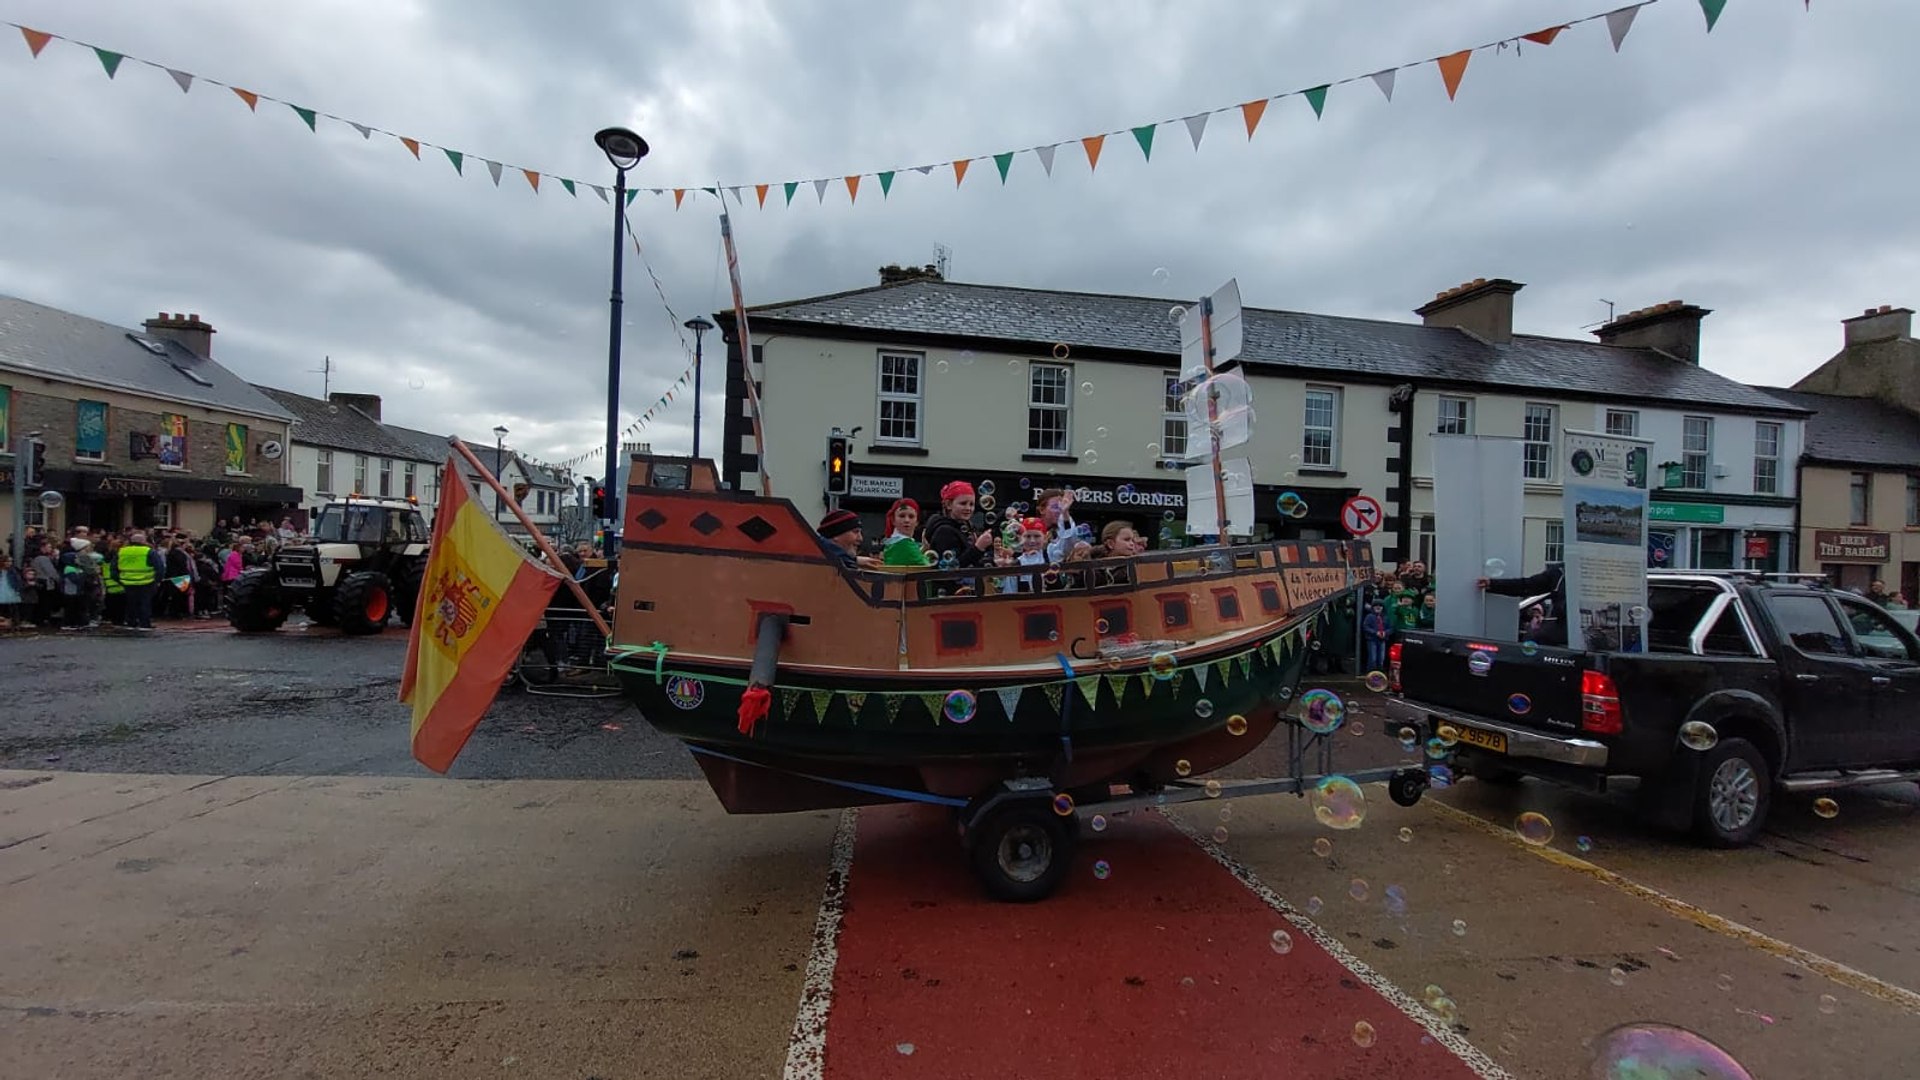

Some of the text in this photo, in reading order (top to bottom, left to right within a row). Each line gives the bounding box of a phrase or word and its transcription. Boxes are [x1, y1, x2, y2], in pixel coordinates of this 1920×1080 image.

[1118, 492, 1185, 507] CORNER
[1819, 542, 1886, 557] THE BARBER
[1468, 728, 1501, 749] 9678
